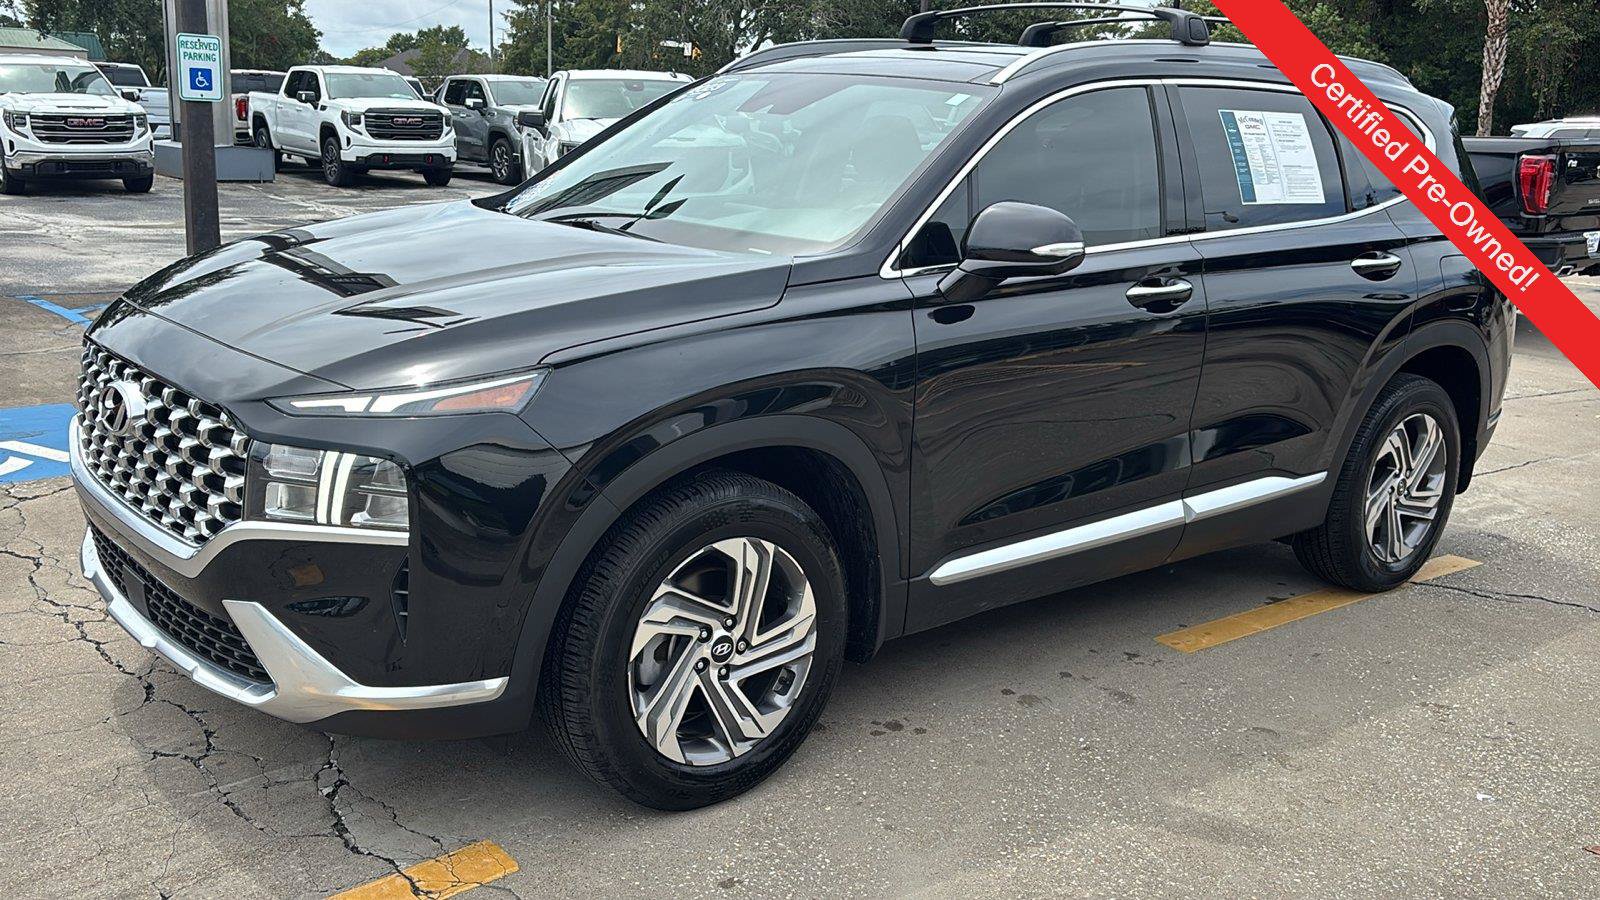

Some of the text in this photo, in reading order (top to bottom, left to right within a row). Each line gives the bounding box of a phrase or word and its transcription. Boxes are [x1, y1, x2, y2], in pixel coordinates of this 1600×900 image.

[180, 40, 219, 51] RESERVED
[183, 52, 217, 62] PARKING
[67, 118, 104, 126] GMC
